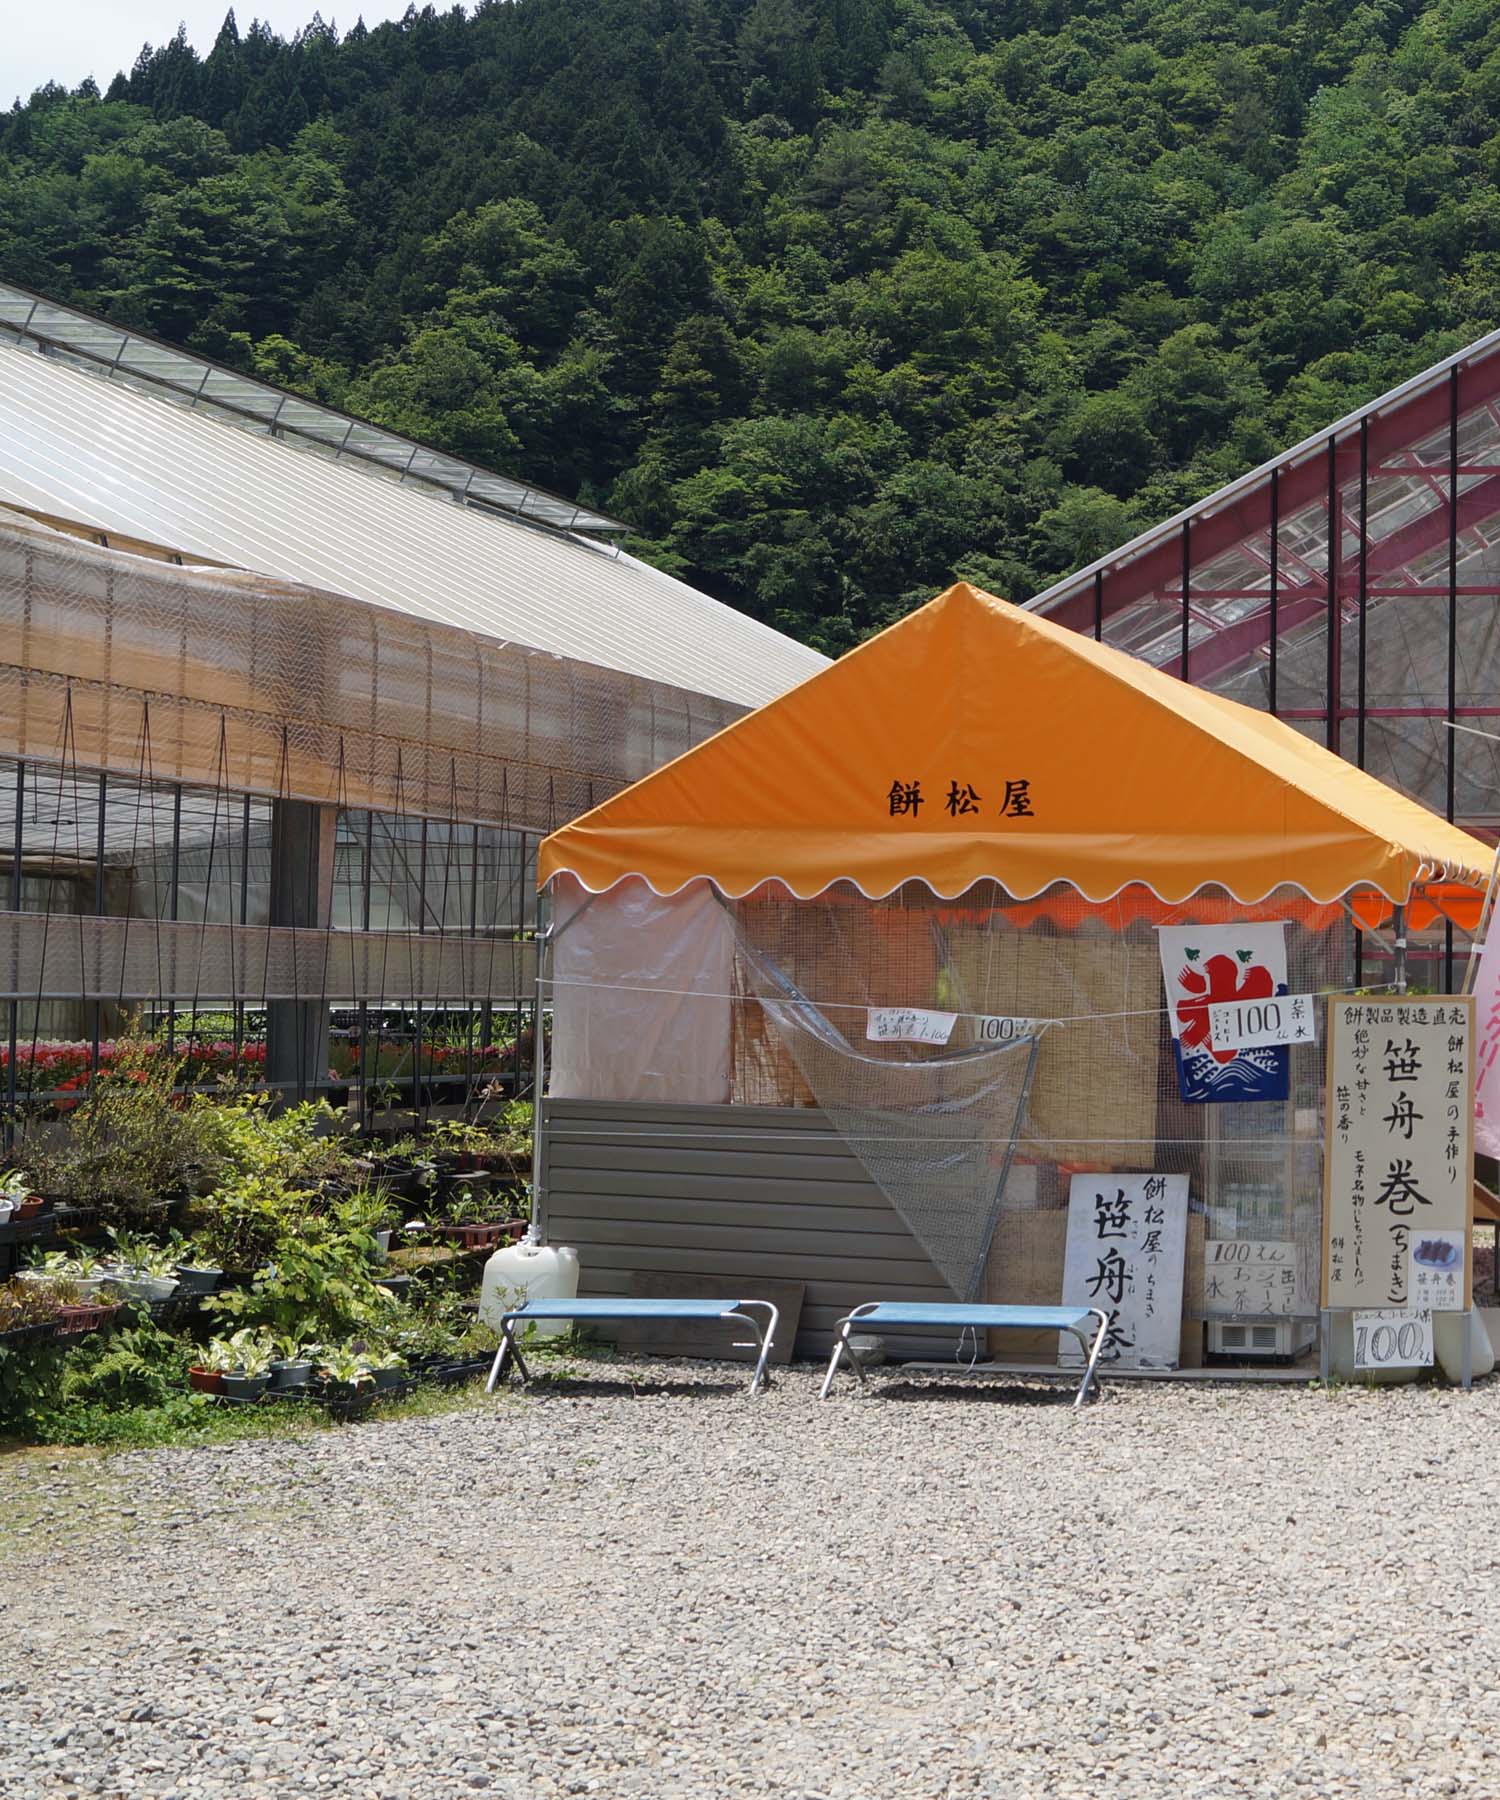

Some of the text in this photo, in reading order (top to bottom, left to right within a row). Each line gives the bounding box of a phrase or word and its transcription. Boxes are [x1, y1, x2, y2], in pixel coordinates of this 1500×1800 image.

[887, 779, 1035, 817] 餅松屋
[1344, 1006, 1466, 1025] 餅製品製造直売
[1351, 1029, 1370, 1116] 絶妙な甘さと
[1336, 1085, 1352, 1144] 笹の香り
[1446, 1035, 1464, 1184] 餅松屋の手作り
[1140, 1176, 1168, 1318] 餅松屋のちまき
